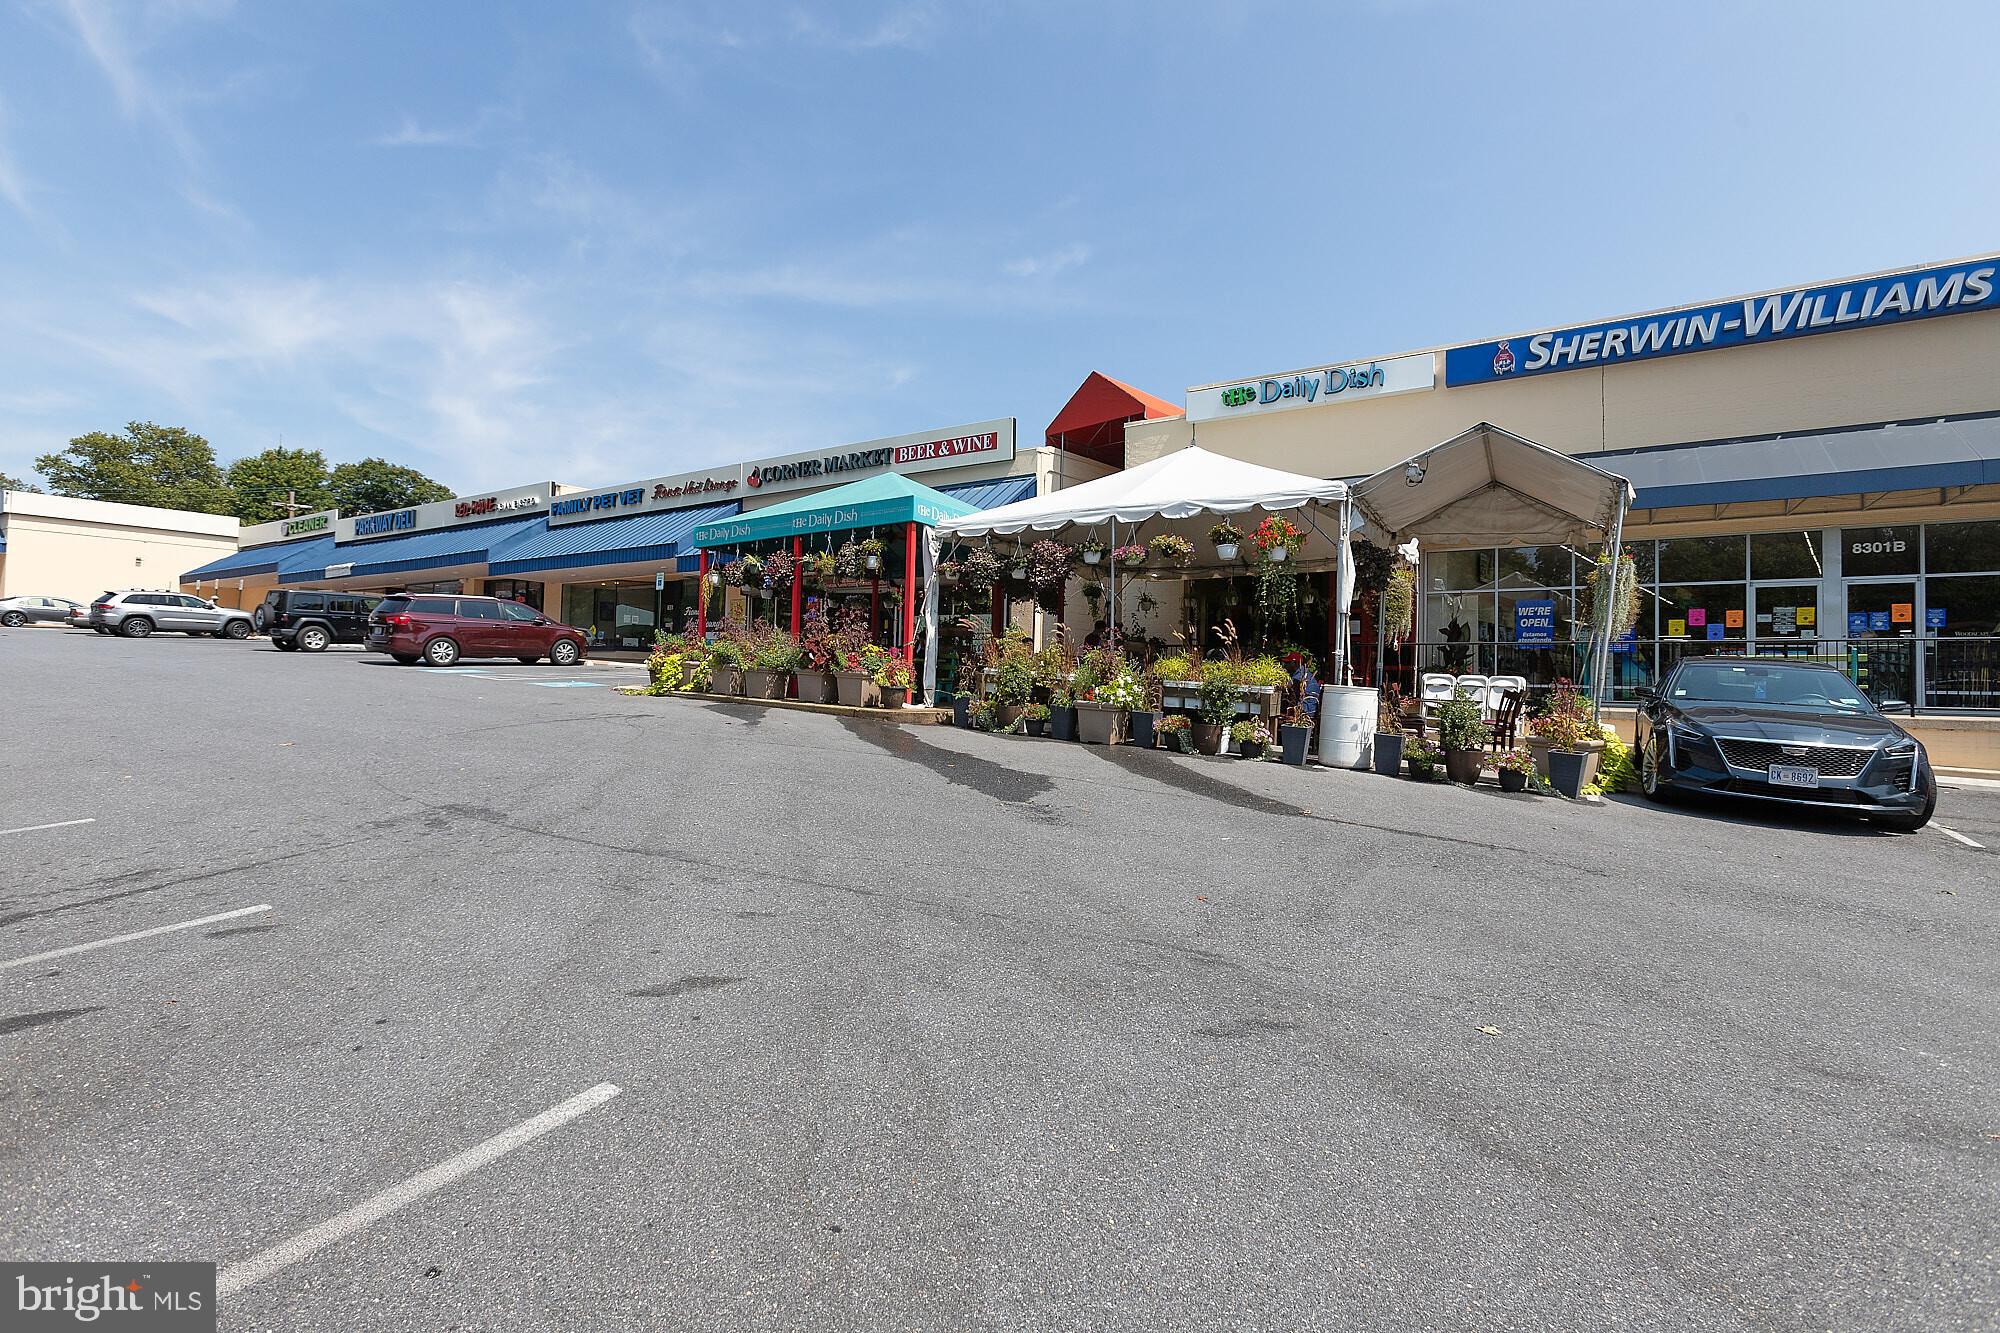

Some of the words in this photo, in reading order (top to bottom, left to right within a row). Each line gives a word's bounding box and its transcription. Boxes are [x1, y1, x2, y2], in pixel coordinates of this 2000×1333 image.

[1524, 267, 1996, 370] SHERWIN-WILLIAMS
[1259, 376, 1319, 404] Daily
[1324, 362, 1384, 394] Dish
[899, 443, 935, 462] BEER
[939, 441, 950, 456] &
[952, 434, 993, 454] WINE
[761, 459, 823, 482] CORNER
[823, 447, 894, 473] MARKET
[551, 496, 593, 516] FAMILY
[592, 492, 619, 510] PET
[618, 488, 646, 506] VET
[355, 514, 395, 536] PARKWAY
[395, 509, 417, 529] DELI
[808, 512, 833, 528] Daily
[834, 508, 858, 524] Dish
[709, 527, 730, 541] Daily
[731, 523, 751, 538] Dish
[1852, 540, 1906, 554] 8301B
[1518, 606, 1552, 616] WE'RE
[1520, 618, 1549, 628] OPEN
[1771, 770, 1782, 780] CK
